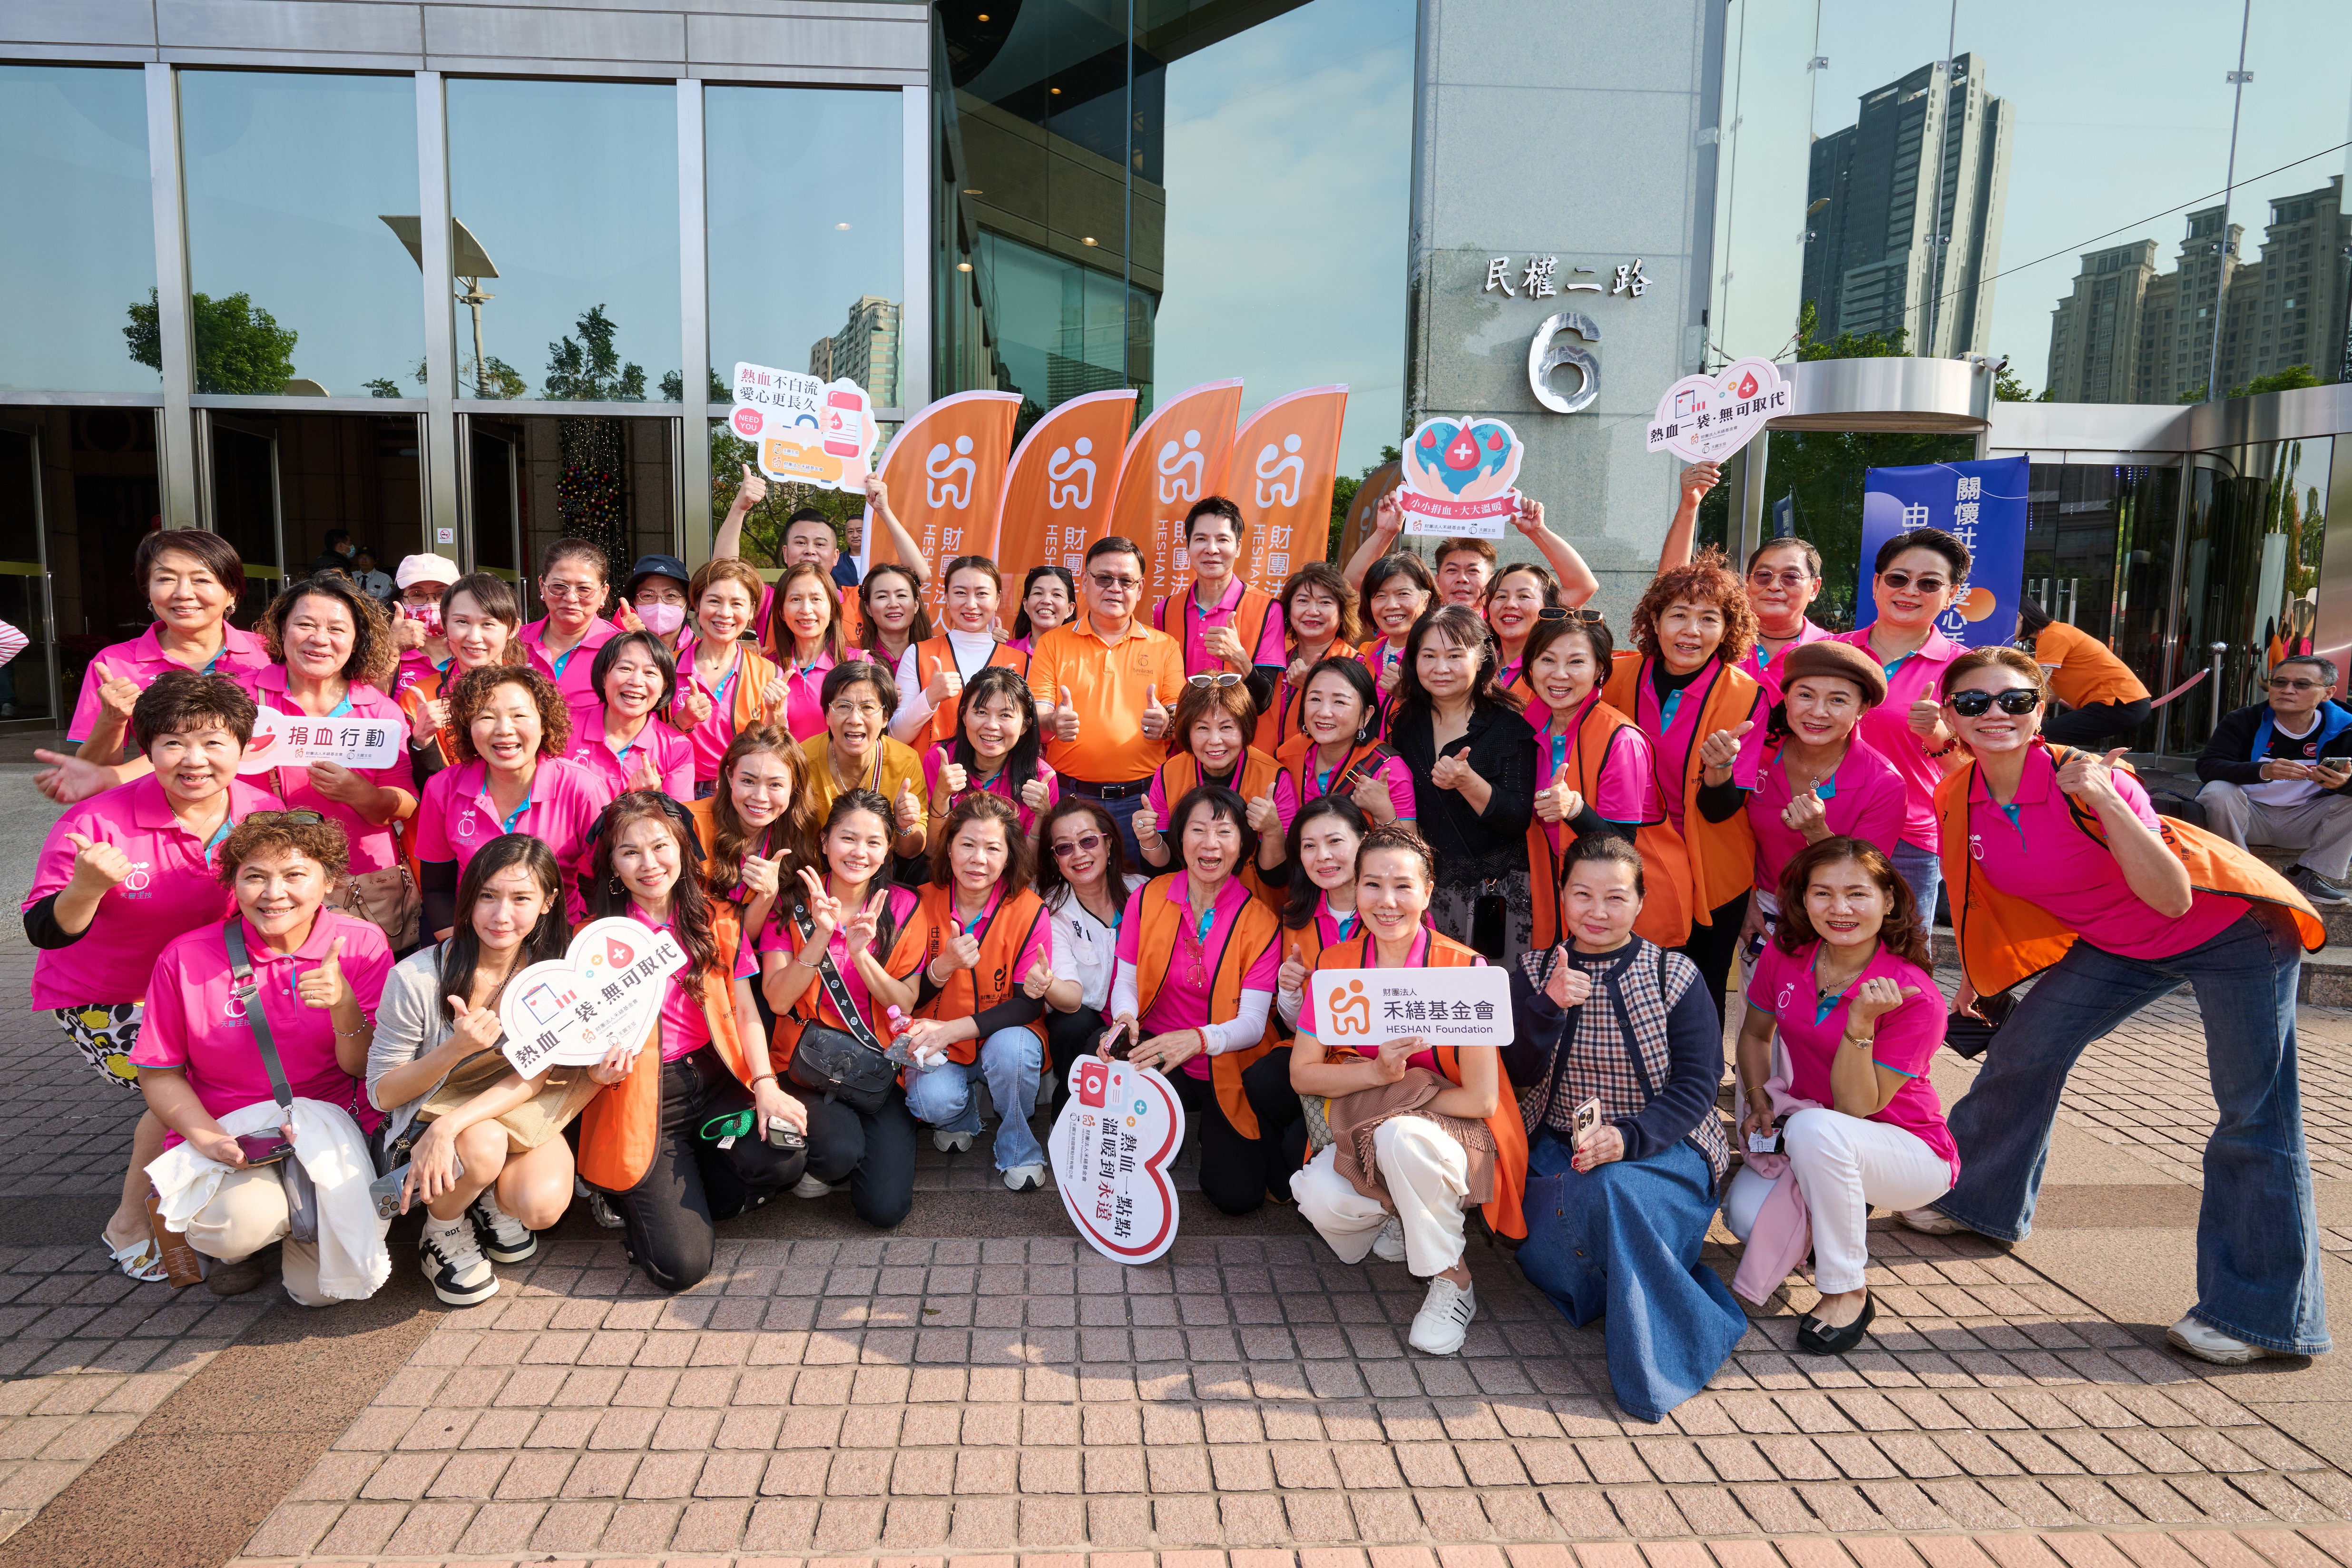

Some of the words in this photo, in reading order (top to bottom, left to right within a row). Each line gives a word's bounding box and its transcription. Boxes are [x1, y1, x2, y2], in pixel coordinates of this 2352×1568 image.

[1485, 253, 1653, 298] 民權二路
[1529, 312, 1602, 413] 6
[741, 368, 818, 396] 熱血不白流
[739, 386, 817, 412] 愛心更長久
[739, 414, 759, 423] NEED
[740, 422, 757, 431] YOU
[1900, 502, 1929, 532] 由
[1953, 477, 1981, 572] 關懷社
[920, 524, 936, 594] HESHN
[1044, 525, 1058, 567] HESH
[1153, 520, 1168, 587] HESHAN
[288, 726, 384, 747] 捐血行動
[120, 891, 152, 899] 天麗生技
[1383, 988, 1417, 997] 財團法人
[1384, 1000, 1494, 1020] 禾繕基金會
[1387, 1025, 1431, 1033] HESHAN
[1436, 1025, 1493, 1033] Foundation
[1082, 1129, 1090, 1182] 財團法人禾繕基金會
[1096, 1117, 1118, 1221] 溫暖到永遠
[1114, 1132, 1137, 1238] 熱血一點點
[445, 1227, 460, 1236] ept
